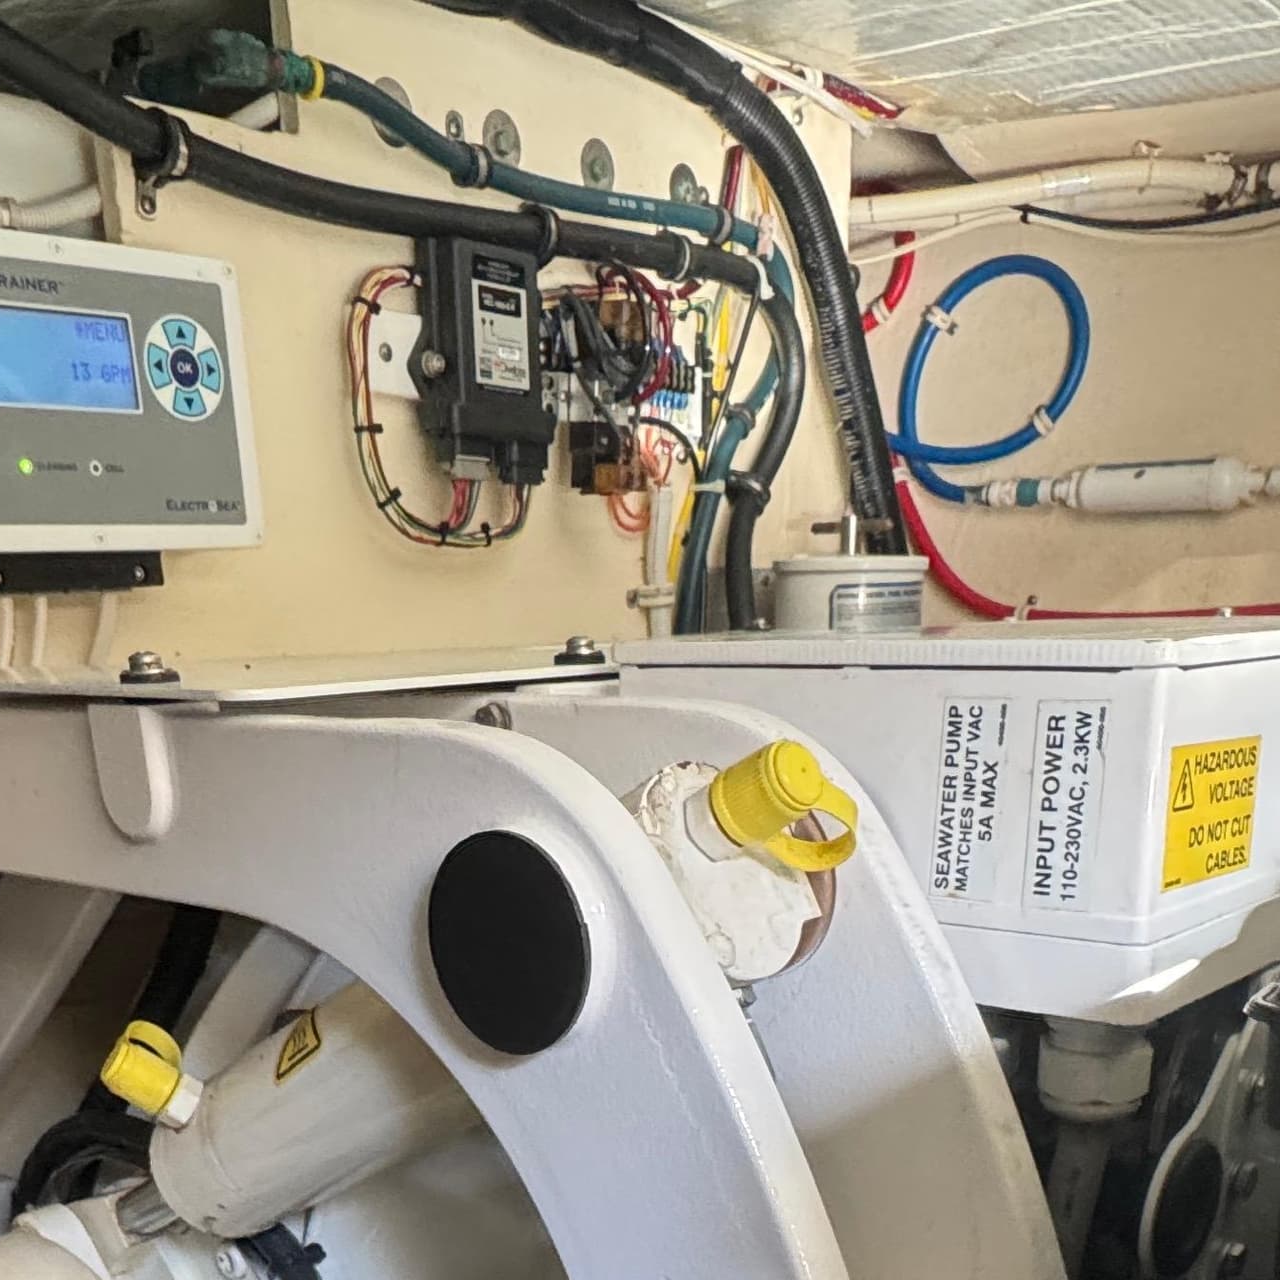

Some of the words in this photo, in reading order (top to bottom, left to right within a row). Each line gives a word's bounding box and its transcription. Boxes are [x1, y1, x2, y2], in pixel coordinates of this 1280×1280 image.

[72, 362, 91, 381] 13
[101, 364, 132, 384] GPM
[177, 361, 193, 374] OK
[945, 705, 963, 768] PUMP
[966, 705, 983, 742] VAC
[1072, 711, 1093, 775] 2.3KW
[962, 746, 979, 801] INPUT
[980, 760, 999, 808] MAX
[1040, 714, 1066, 812] POWER
[1194, 746, 1257, 775] HAZARDOUS
[1209, 777, 1254, 804] VOLTAGE
[934, 775, 958, 890] SEAWATER
[954, 807, 974, 892] MATCHES
[978, 814, 994, 842] 5A
[1060, 781, 1090, 902] 110-230VAC,
[1189, 823, 1205, 848] DO
[1207, 819, 1229, 844] NOT
[1231, 814, 1251, 838] CUT
[1033, 820, 1057, 896] INPUT
[1205, 845, 1247, 874] CABLES.
